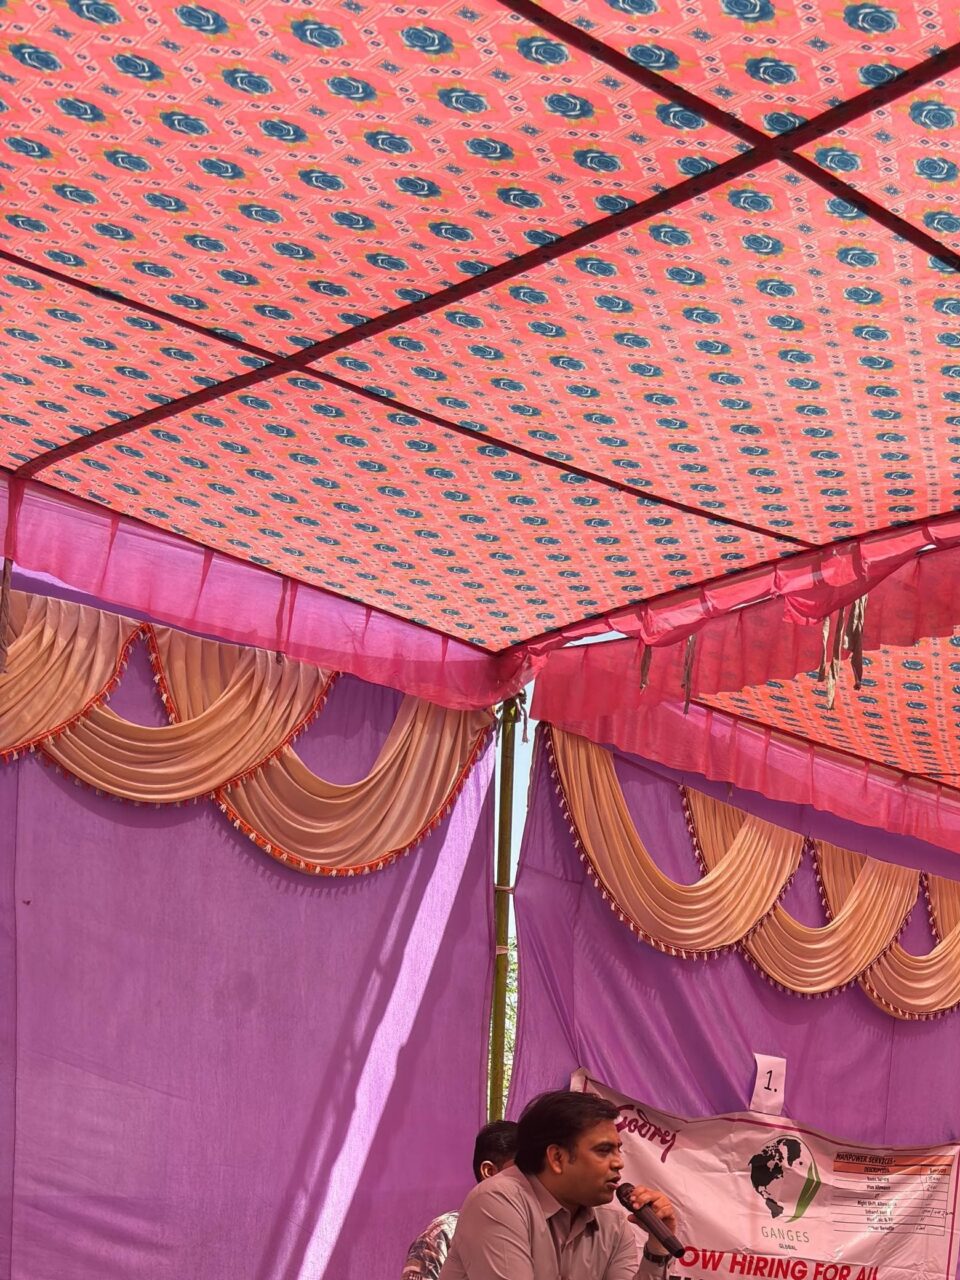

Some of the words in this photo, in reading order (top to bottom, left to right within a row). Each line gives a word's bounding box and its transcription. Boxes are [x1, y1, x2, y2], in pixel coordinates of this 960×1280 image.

[764, 1070, 778, 1093] 1.
[761, 1226, 810, 1243] GANGES
[779, 1243, 797, 1251] GLOBAL
[679, 1246, 726, 1272] OW
